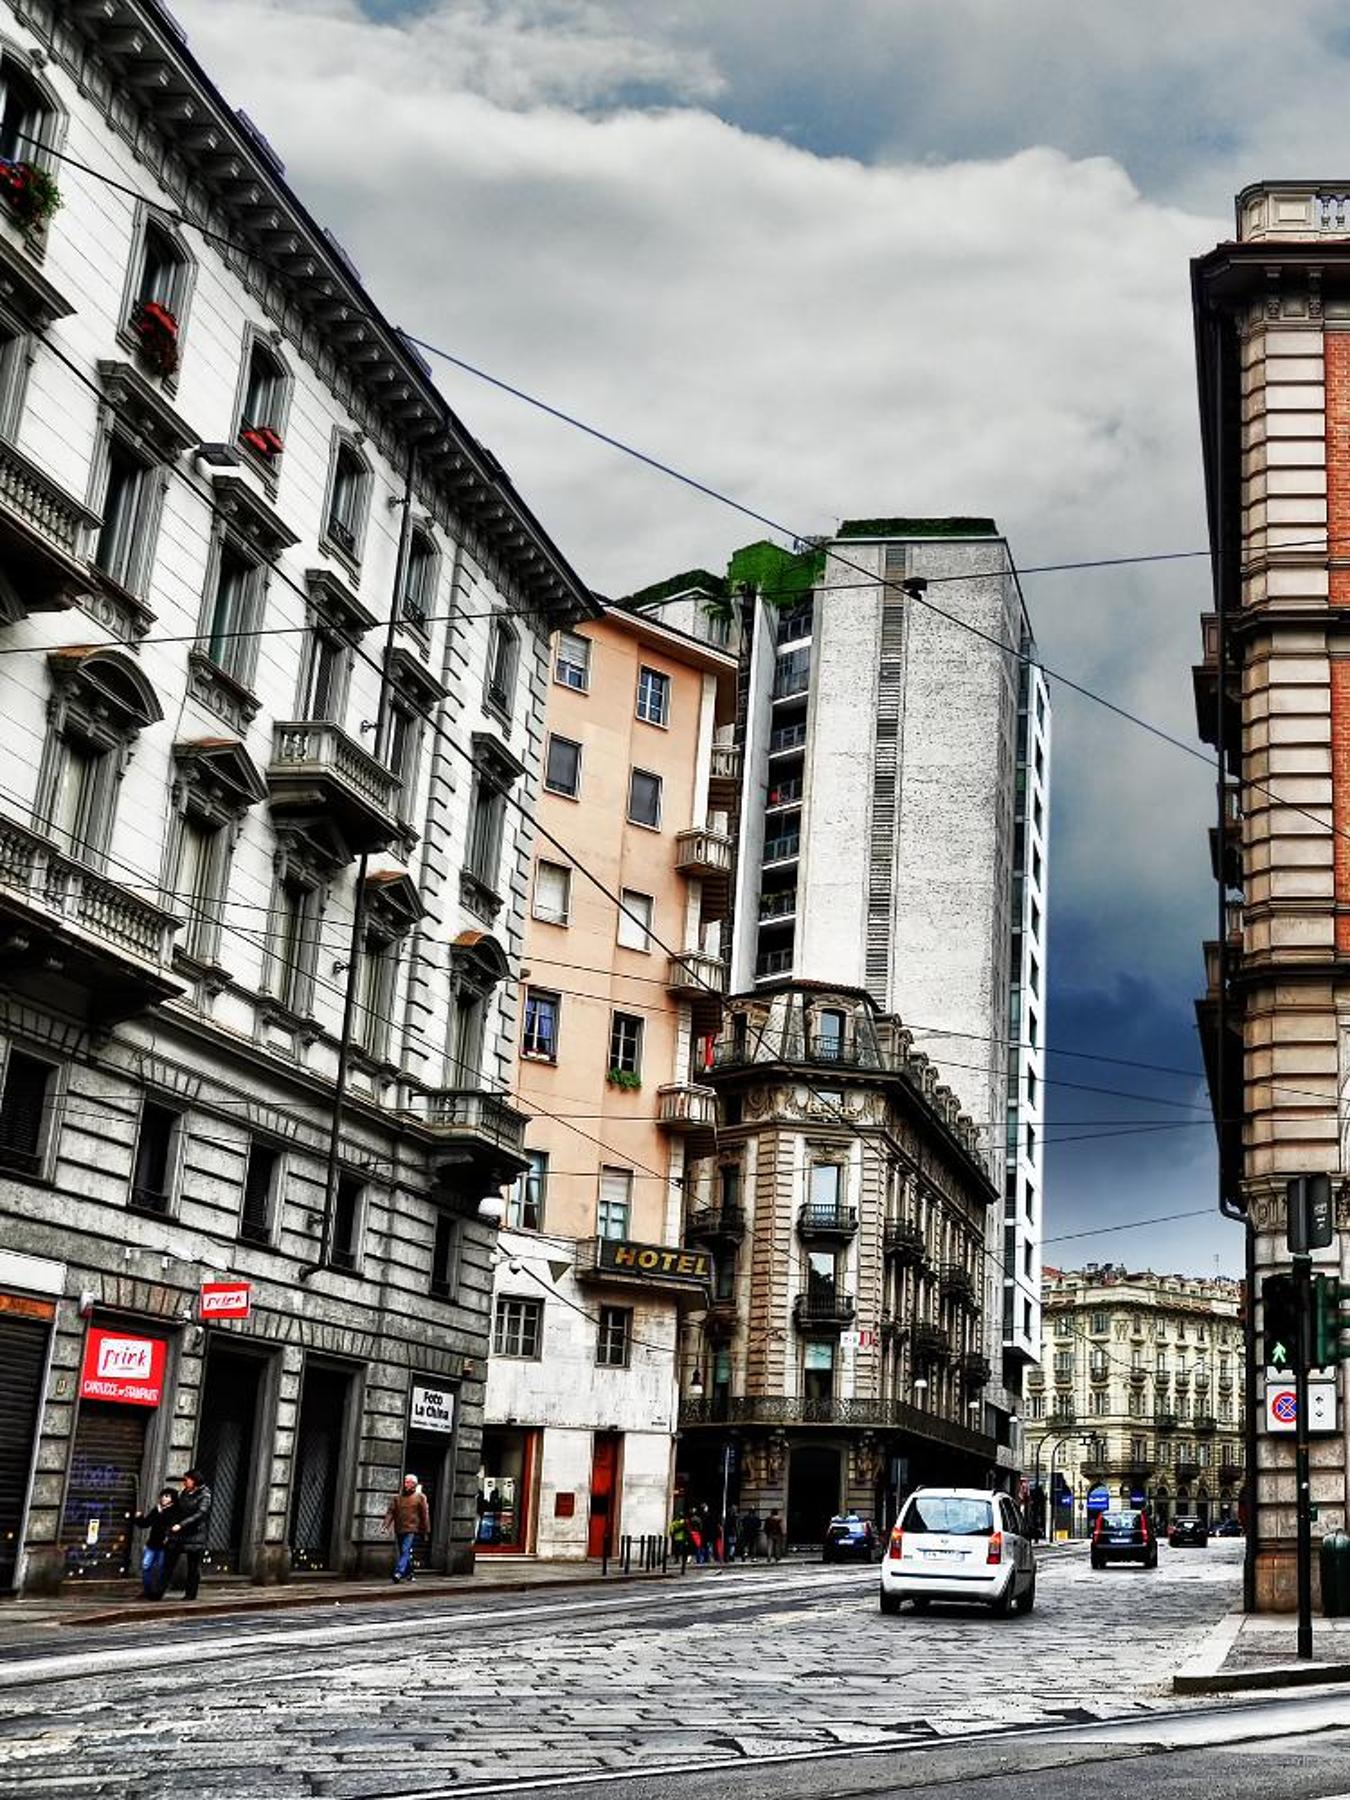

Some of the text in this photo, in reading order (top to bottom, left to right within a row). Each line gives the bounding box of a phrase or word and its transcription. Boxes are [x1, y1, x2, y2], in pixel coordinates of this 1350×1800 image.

[614, 1247, 709, 1275] HOTEL
[424, 1391, 443, 1406] Foto
[415, 1403, 449, 1420] La China
